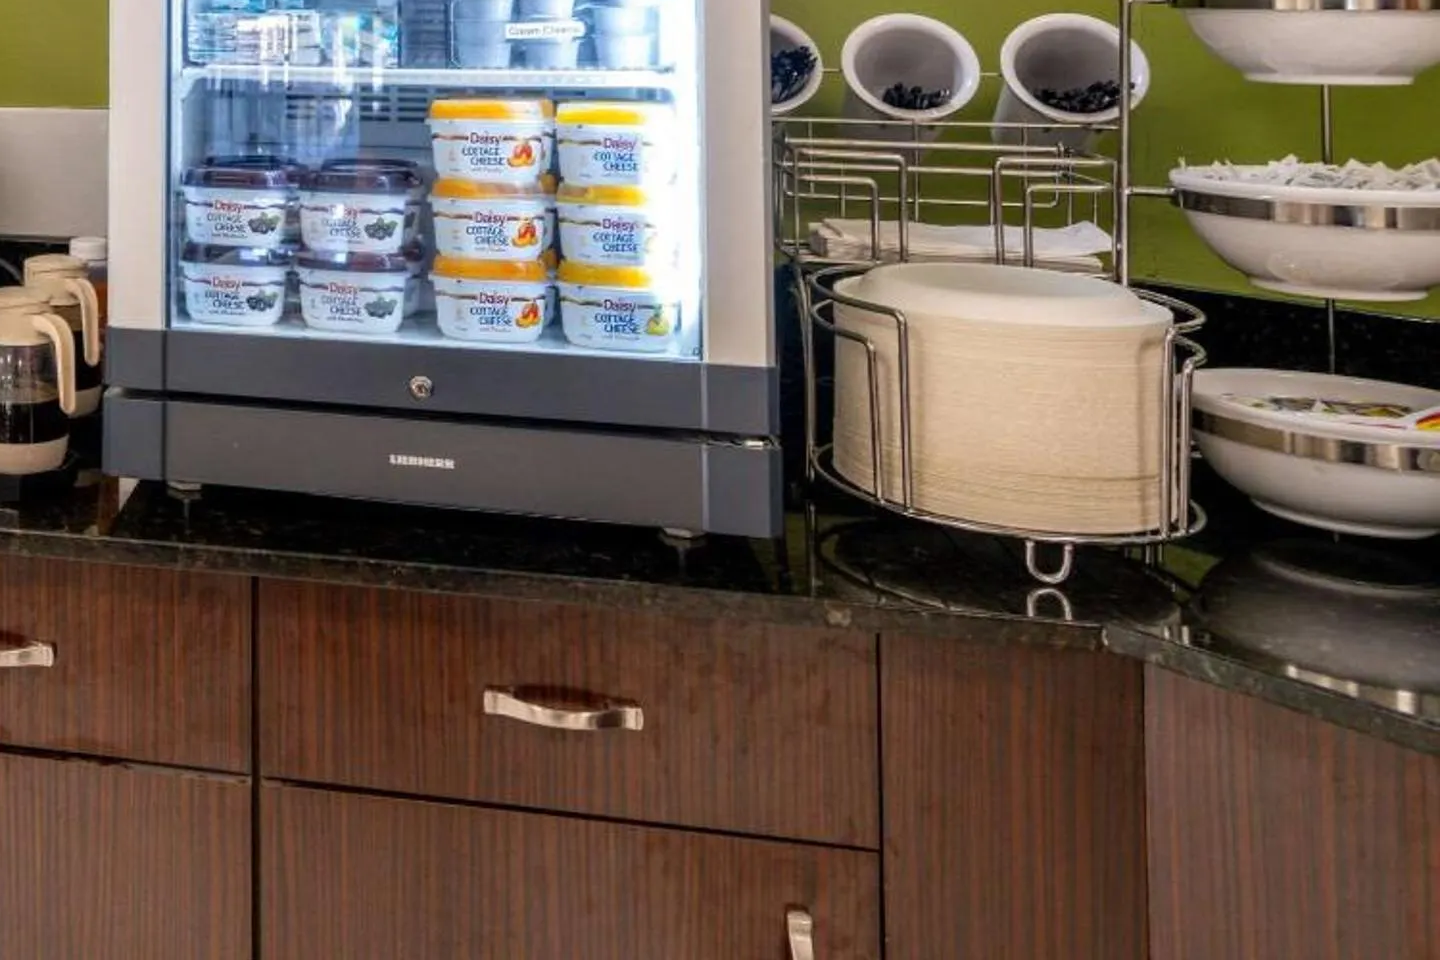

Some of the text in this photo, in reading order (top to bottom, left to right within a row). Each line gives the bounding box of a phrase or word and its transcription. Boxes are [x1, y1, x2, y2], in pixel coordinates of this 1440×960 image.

[470, 132, 501, 145] Daisy
[603, 136, 636, 151] Daisy
[603, 161, 638, 172] CHEESE
[475, 210, 506, 226] Daisy
[602, 217, 637, 231] Daisy
[602, 242, 639, 253] CHEESE
[213, 276, 242, 290] Daisy
[329, 282, 358, 295] Daisy
[479, 291, 510, 305] Daisy
[603, 298, 636, 312] Daisy
